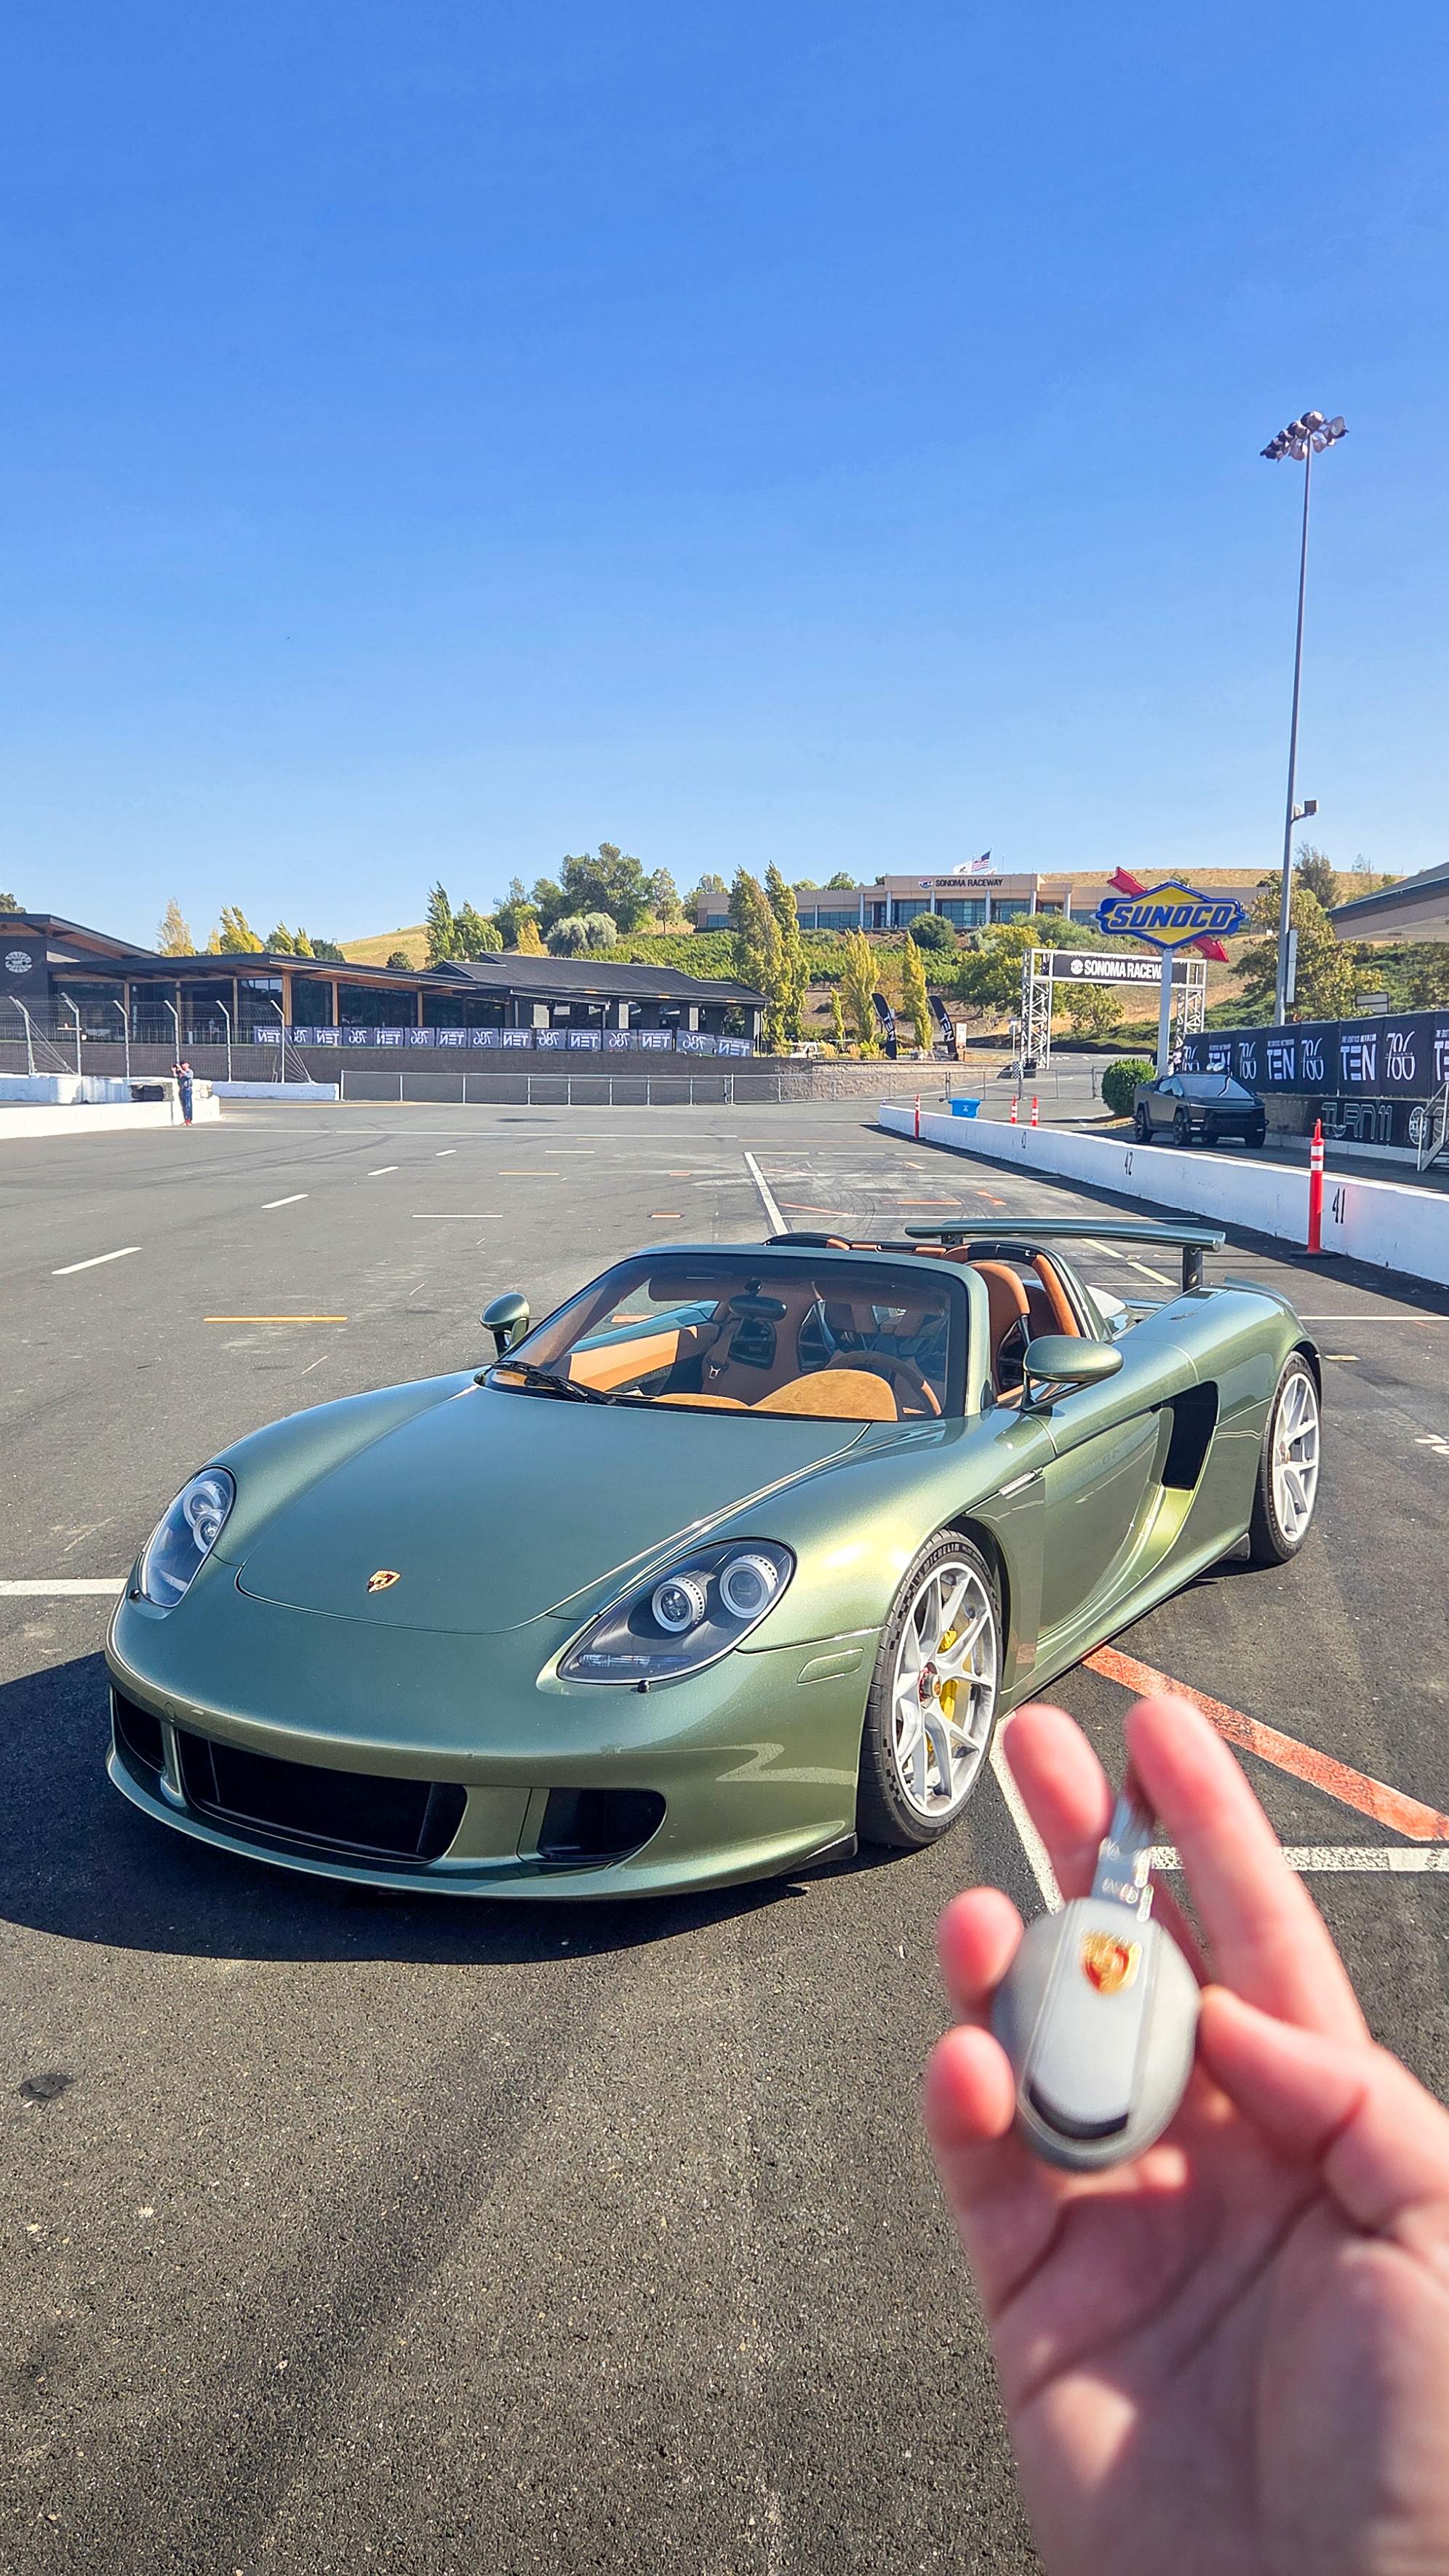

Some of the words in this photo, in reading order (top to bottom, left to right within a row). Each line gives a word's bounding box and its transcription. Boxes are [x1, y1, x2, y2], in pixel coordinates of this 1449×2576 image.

[935, 879, 966, 887] SONOMA
[967, 879, 1004, 887] RACEWAY
[1109, 905, 1233, 928] SUNOCO
[1084, 961, 1126, 978] SONOMA
[1127, 962, 1162, 980] RACEW
[884, 1012, 895, 1041] TEN
[940, 1013, 954, 1041] TEN
[1266, 1047, 1295, 1081] TEN
[1340, 1044, 1376, 1081] TEN
[1125, 1150, 1133, 1175] 42
[1332, 1187, 1345, 1224] 41
[923, 1543, 960, 1575] MICHELIN
